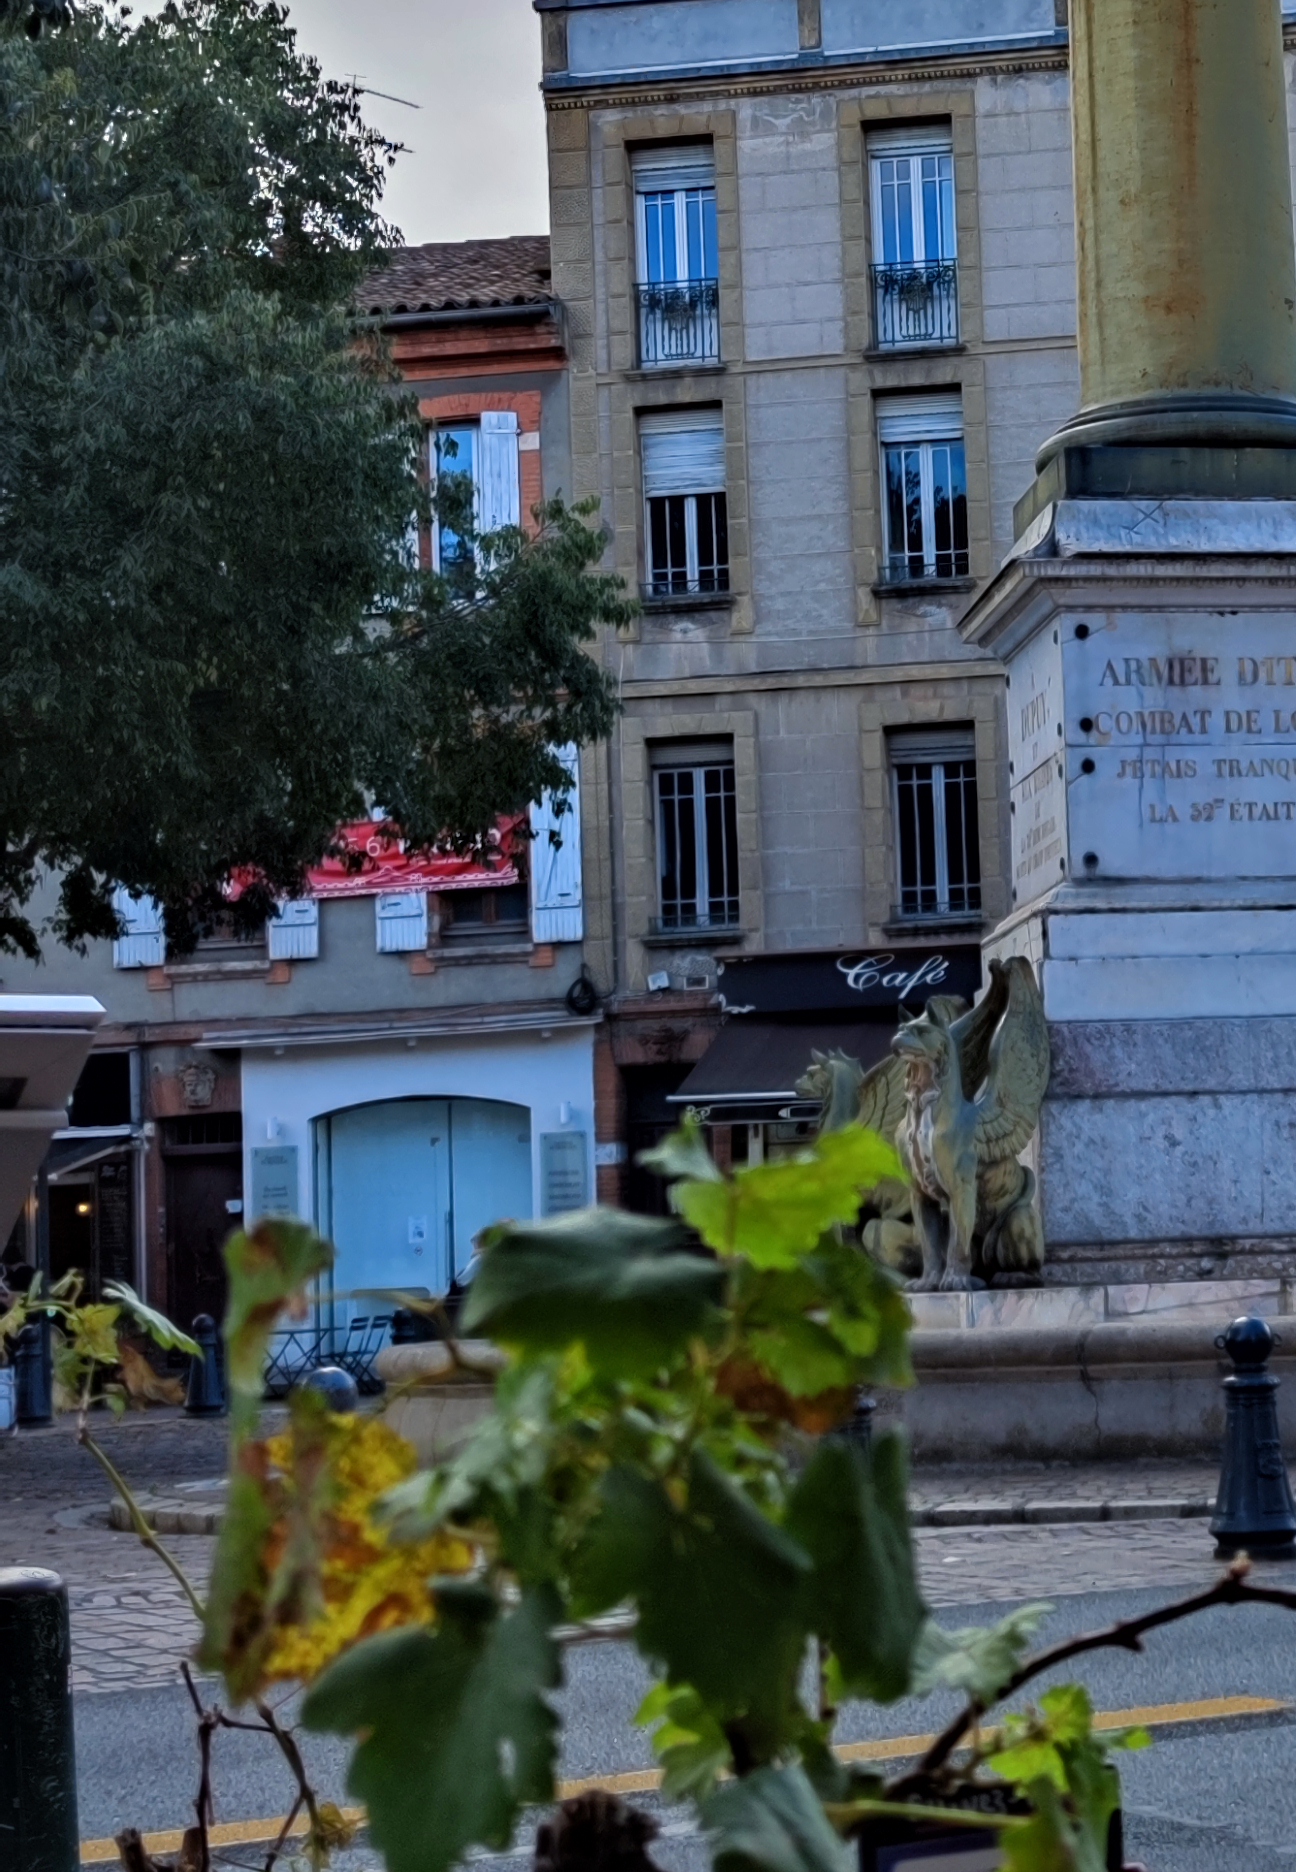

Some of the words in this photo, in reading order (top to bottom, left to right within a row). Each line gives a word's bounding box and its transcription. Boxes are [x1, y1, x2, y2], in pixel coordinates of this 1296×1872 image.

[1099, 650, 1221, 686] ARMÉE
[1095, 709, 1212, 735] COMBAT
[1224, 710, 1262, 734] DE
[1149, 803, 1180, 823] LA
[1229, 798, 1296, 821] ÉTAIT
[836, 953, 950, 999] Café
